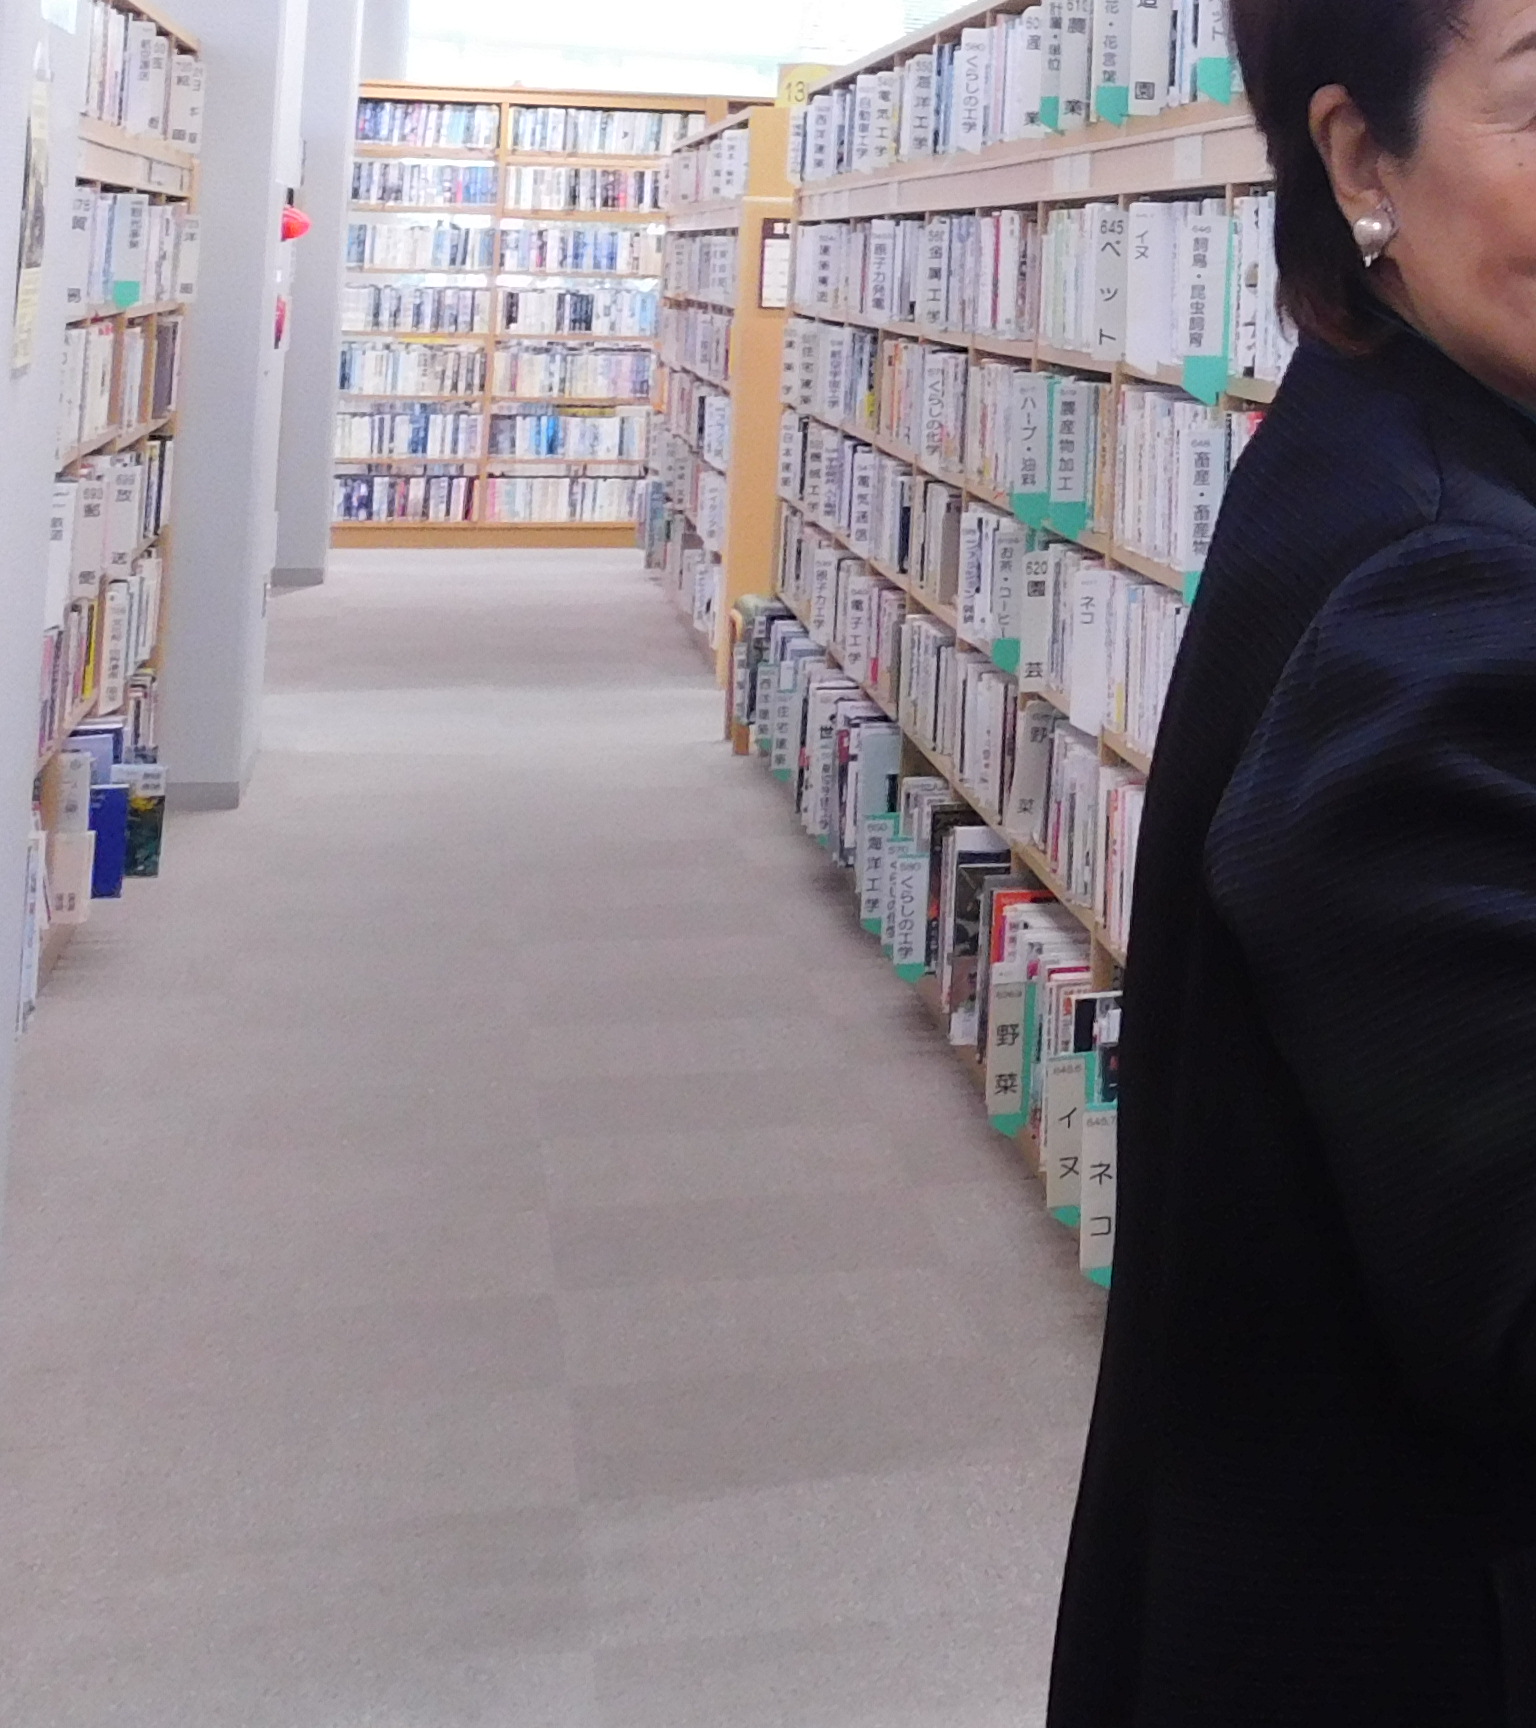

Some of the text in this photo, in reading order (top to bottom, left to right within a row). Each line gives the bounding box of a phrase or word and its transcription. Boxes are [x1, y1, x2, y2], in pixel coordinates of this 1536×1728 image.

[785, 81, 805, 102] 13
[963, 55, 981, 133] くらしの工学
[1024, 34, 1041, 127] 産業
[1063, 17, 1089, 116] 農業
[874, 89, 893, 157] 電気工学
[913, 76, 931, 149] 海洋工学
[1100, 220, 1124, 235] 645
[1133, 233, 1150, 260] イヌ
[872, 243, 888, 310] 原子力発電
[927, 246, 943, 322] 金属工学
[1099, 240, 1121, 345] ペット
[926, 380, 943, 457] くらしの化学
[1020, 397, 1037, 487] ハーブ・油料
[1057, 401, 1077, 491] 農産物加工
[1192, 451, 1211, 556] 畜産・畜産物
[999, 548, 1013, 638] お茶・コーヒー
[1026, 561, 1048, 575] 620
[847, 598, 864, 663] 電子工学
[1025, 580, 1046, 679] 園芸
[1080, 596, 1095, 625] ネコ
[1017, 726, 1046, 814] 野菜
[864, 836, 882, 913] 海洋工学
[897, 875, 915, 959] くらしの工学
[994, 1023, 1020, 1096] 野菜
[1058, 1107, 1080, 1179] イヌ
[1090, 1162, 1113, 1237] ネコ
